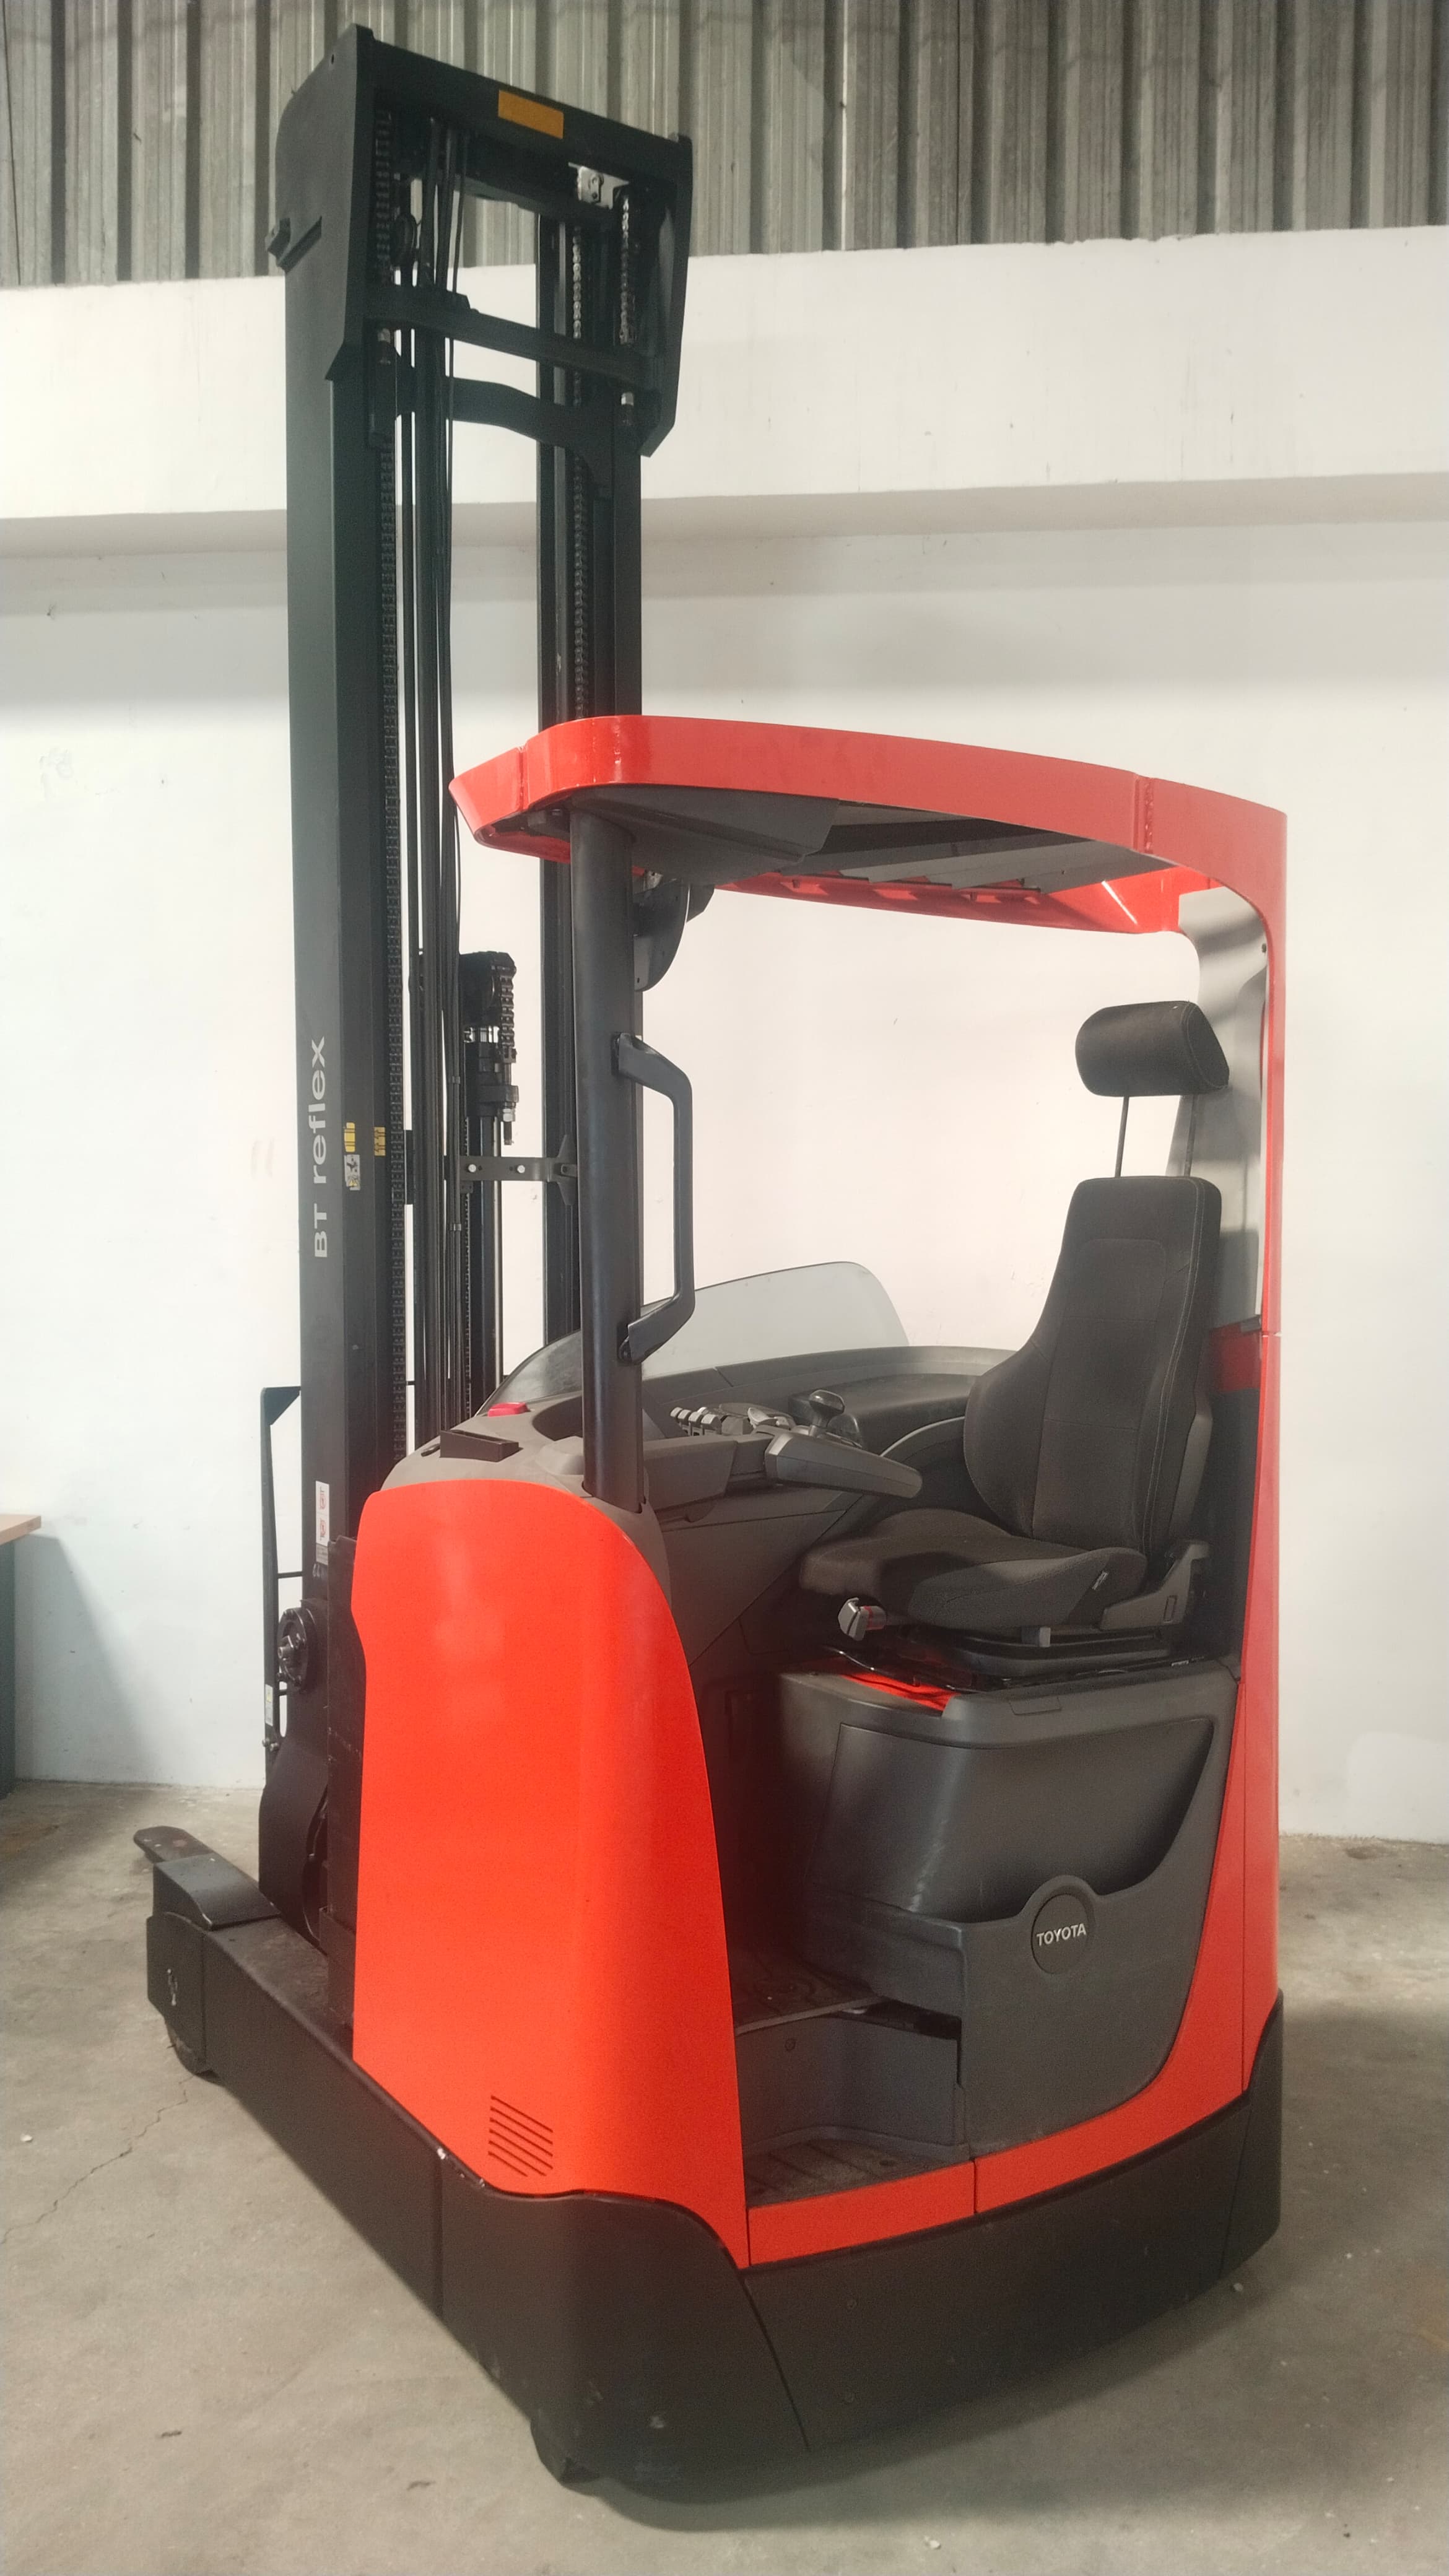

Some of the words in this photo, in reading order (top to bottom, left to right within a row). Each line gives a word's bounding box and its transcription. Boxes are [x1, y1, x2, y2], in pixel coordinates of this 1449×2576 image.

[308, 1036, 327, 1184] reflex
[314, 1203, 328, 1258] BT
[1037, 1923, 1087, 1946] TOYOTA
